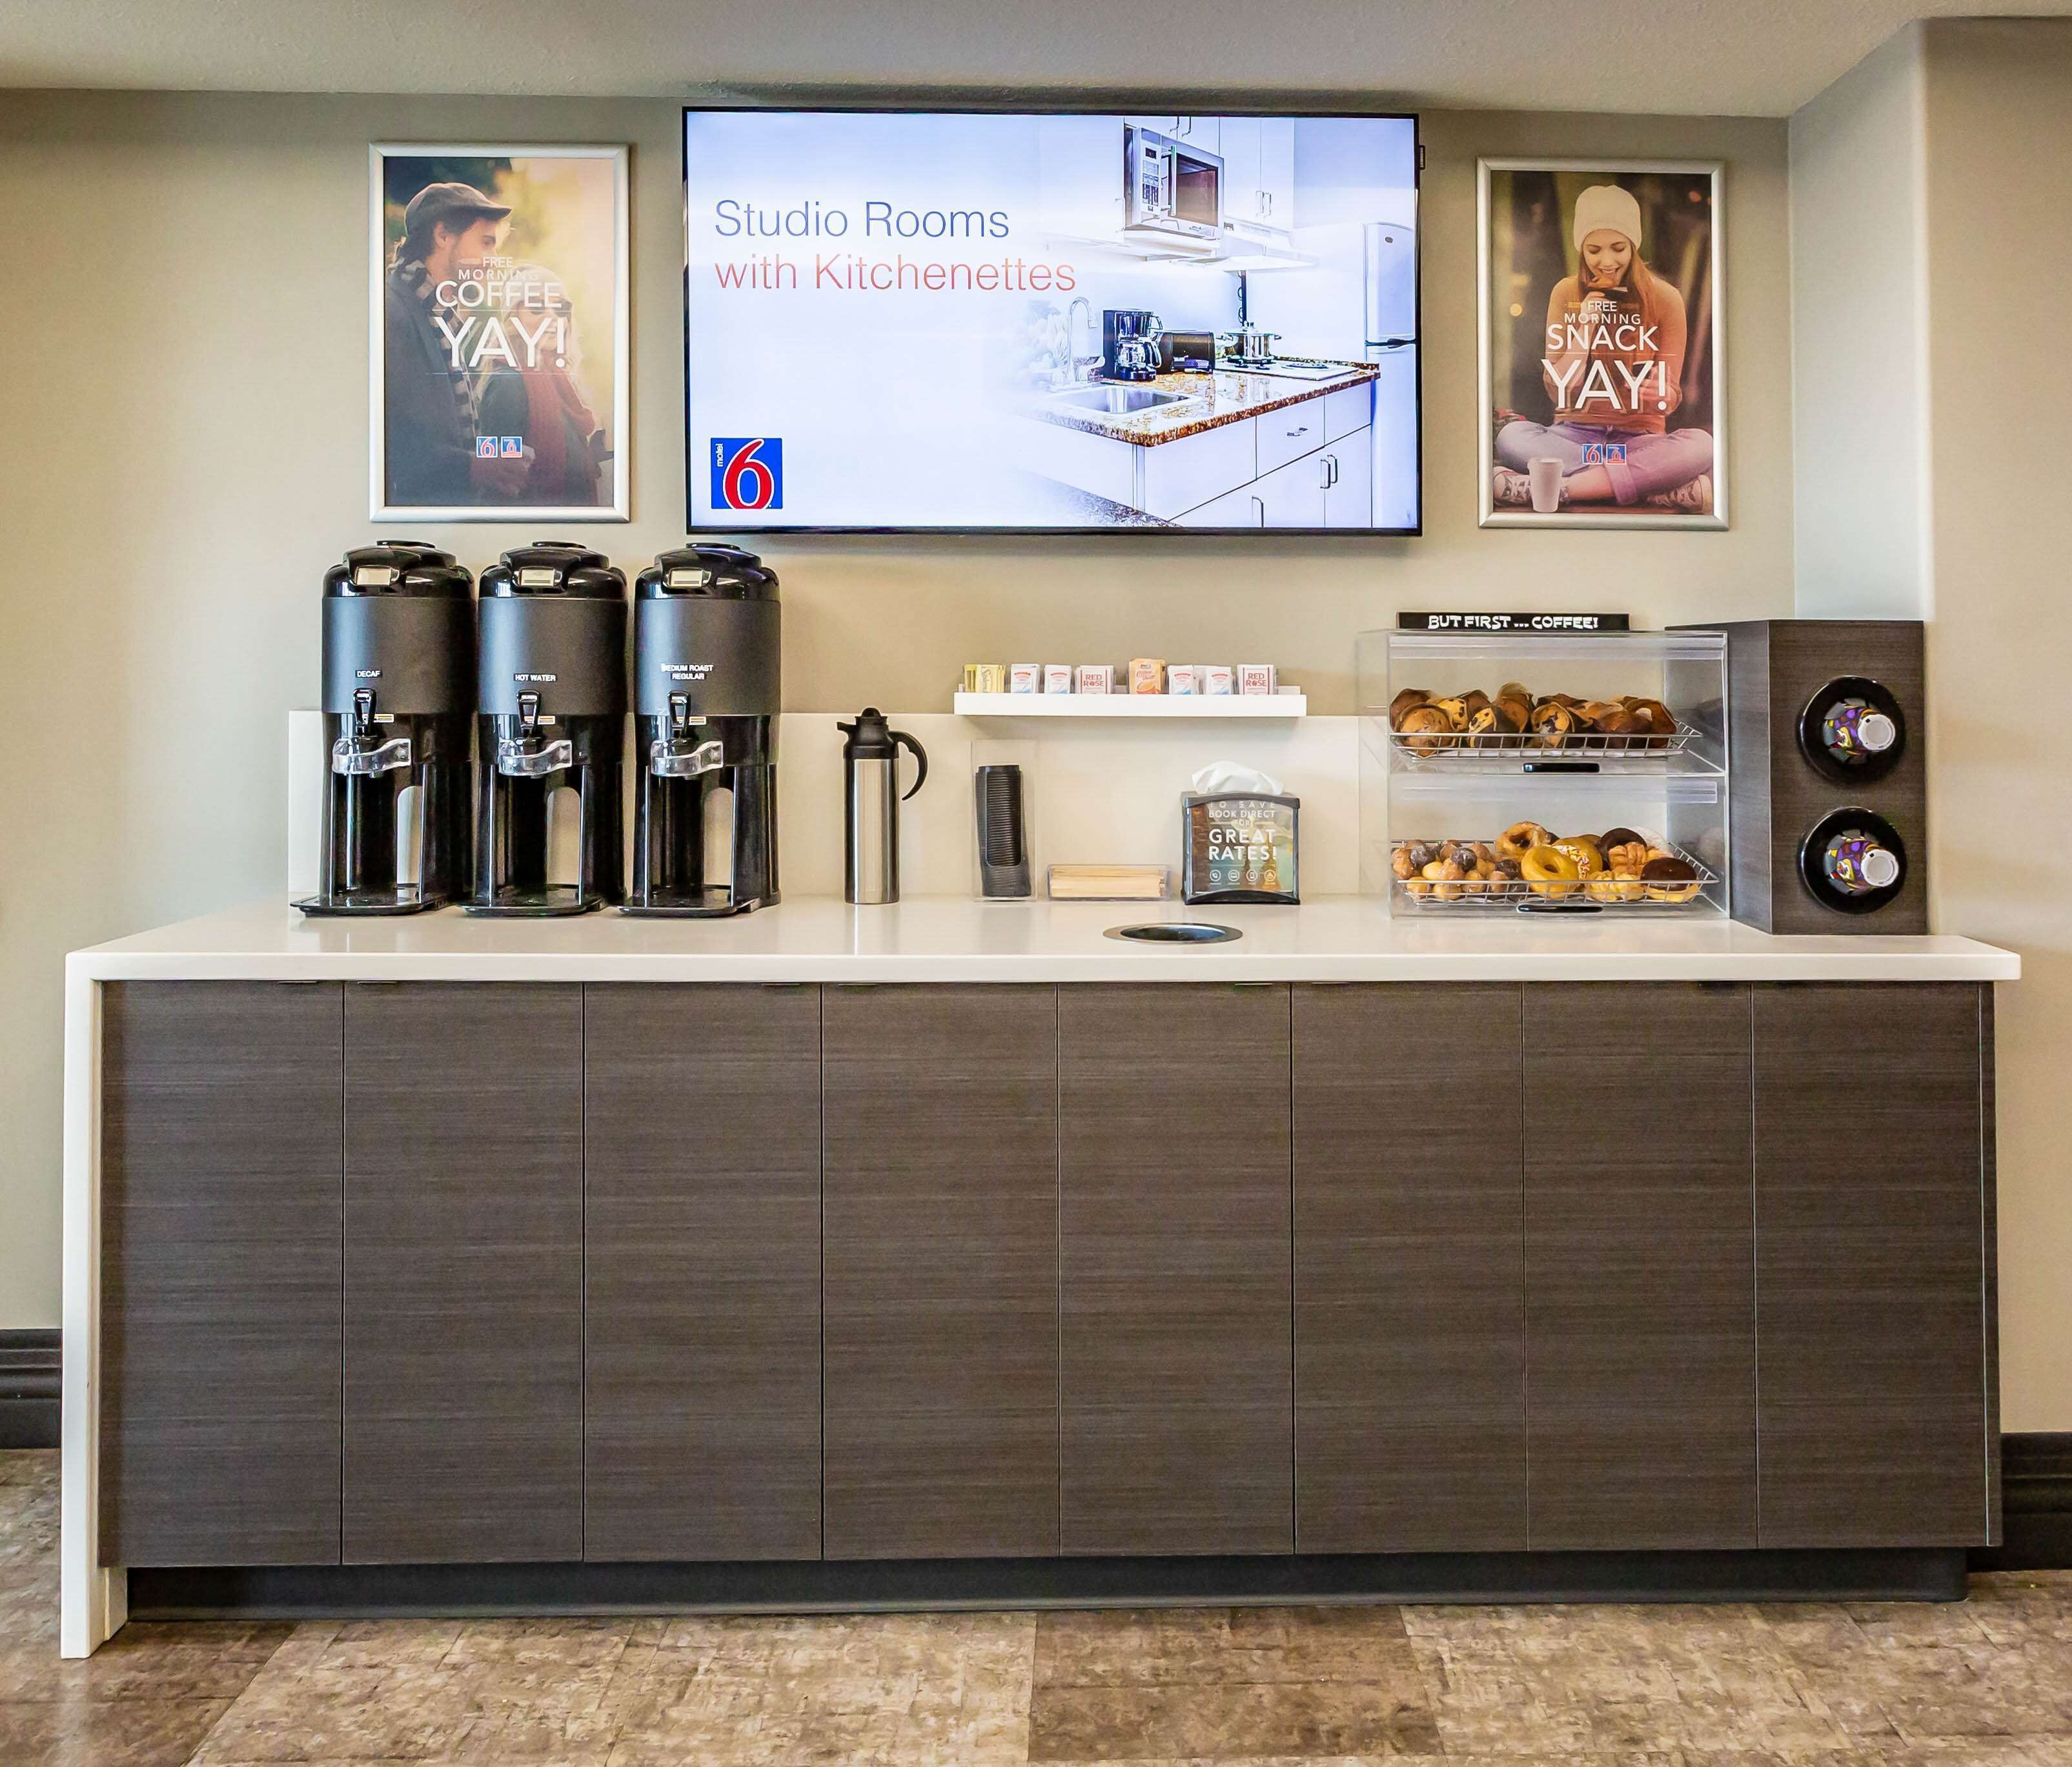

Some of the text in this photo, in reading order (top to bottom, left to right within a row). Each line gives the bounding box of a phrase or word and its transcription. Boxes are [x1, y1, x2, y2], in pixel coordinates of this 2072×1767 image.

[715, 199, 1010, 238] Studio Rooms
[482, 256, 514, 268] FREE
[715, 253, 1076, 291] with Kitchenettes
[458, 269, 538, 280] MORNING
[435, 280, 562, 307] COFFEE
[1588, 301, 1618, 312] FREE
[1564, 313, 1641, 324] MORNING
[434, 316, 565, 368] YAY!
[1547, 323, 1660, 352] SNACK
[1540, 358, 1667, 411] YAY!
[715, 438, 775, 509] motel 6
[1427, 615, 1461, 629] BUT
[1464, 615, 1511, 629] FIRST
[1532, 616, 1599, 629] COFFEE!
[1208, 828, 1276, 844] GREAT
[1208, 846, 1277, 861] RATES!
